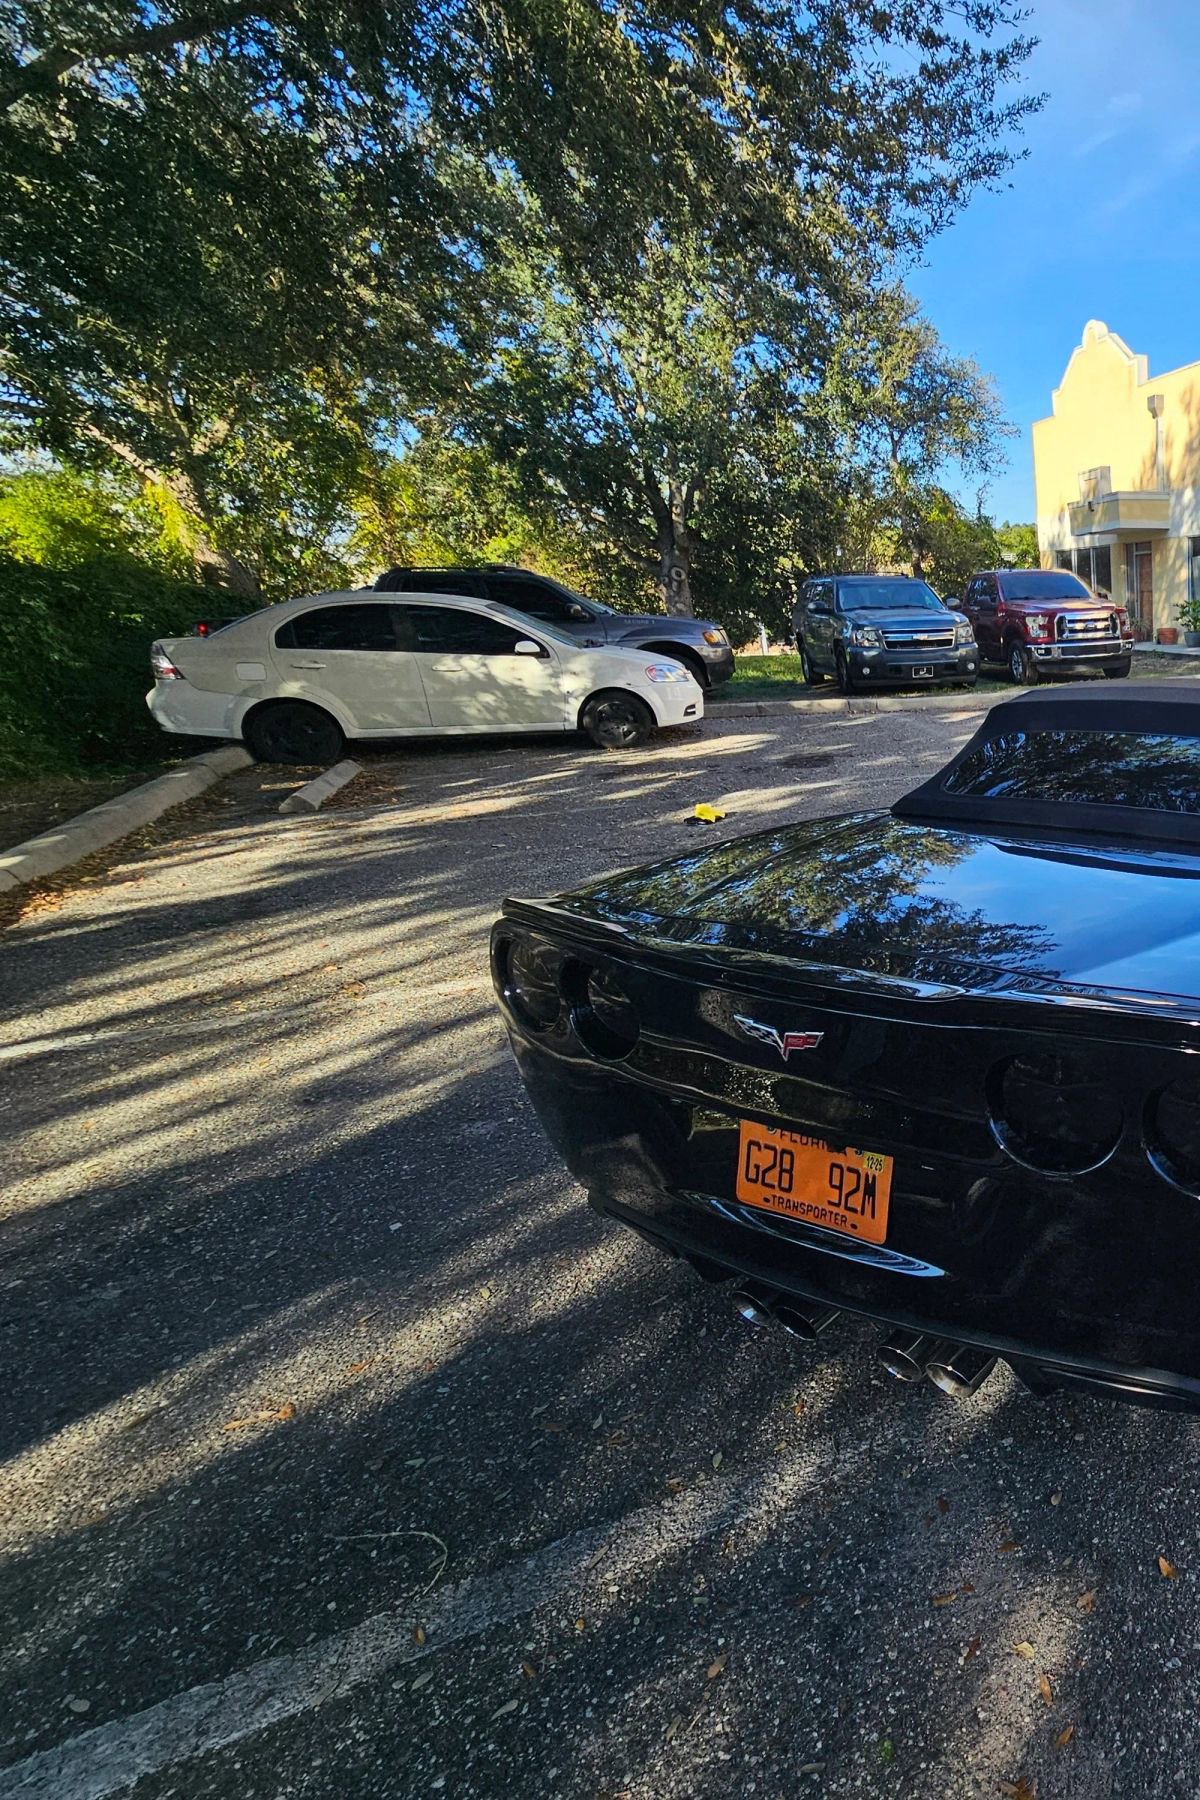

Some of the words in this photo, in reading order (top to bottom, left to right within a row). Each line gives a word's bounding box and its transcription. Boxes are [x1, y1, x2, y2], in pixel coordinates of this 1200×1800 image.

[744, 1139, 795, 1194] G28
[827, 1161, 877, 1220] 92M
[770, 1194, 848, 1226] TRANSPORTER
